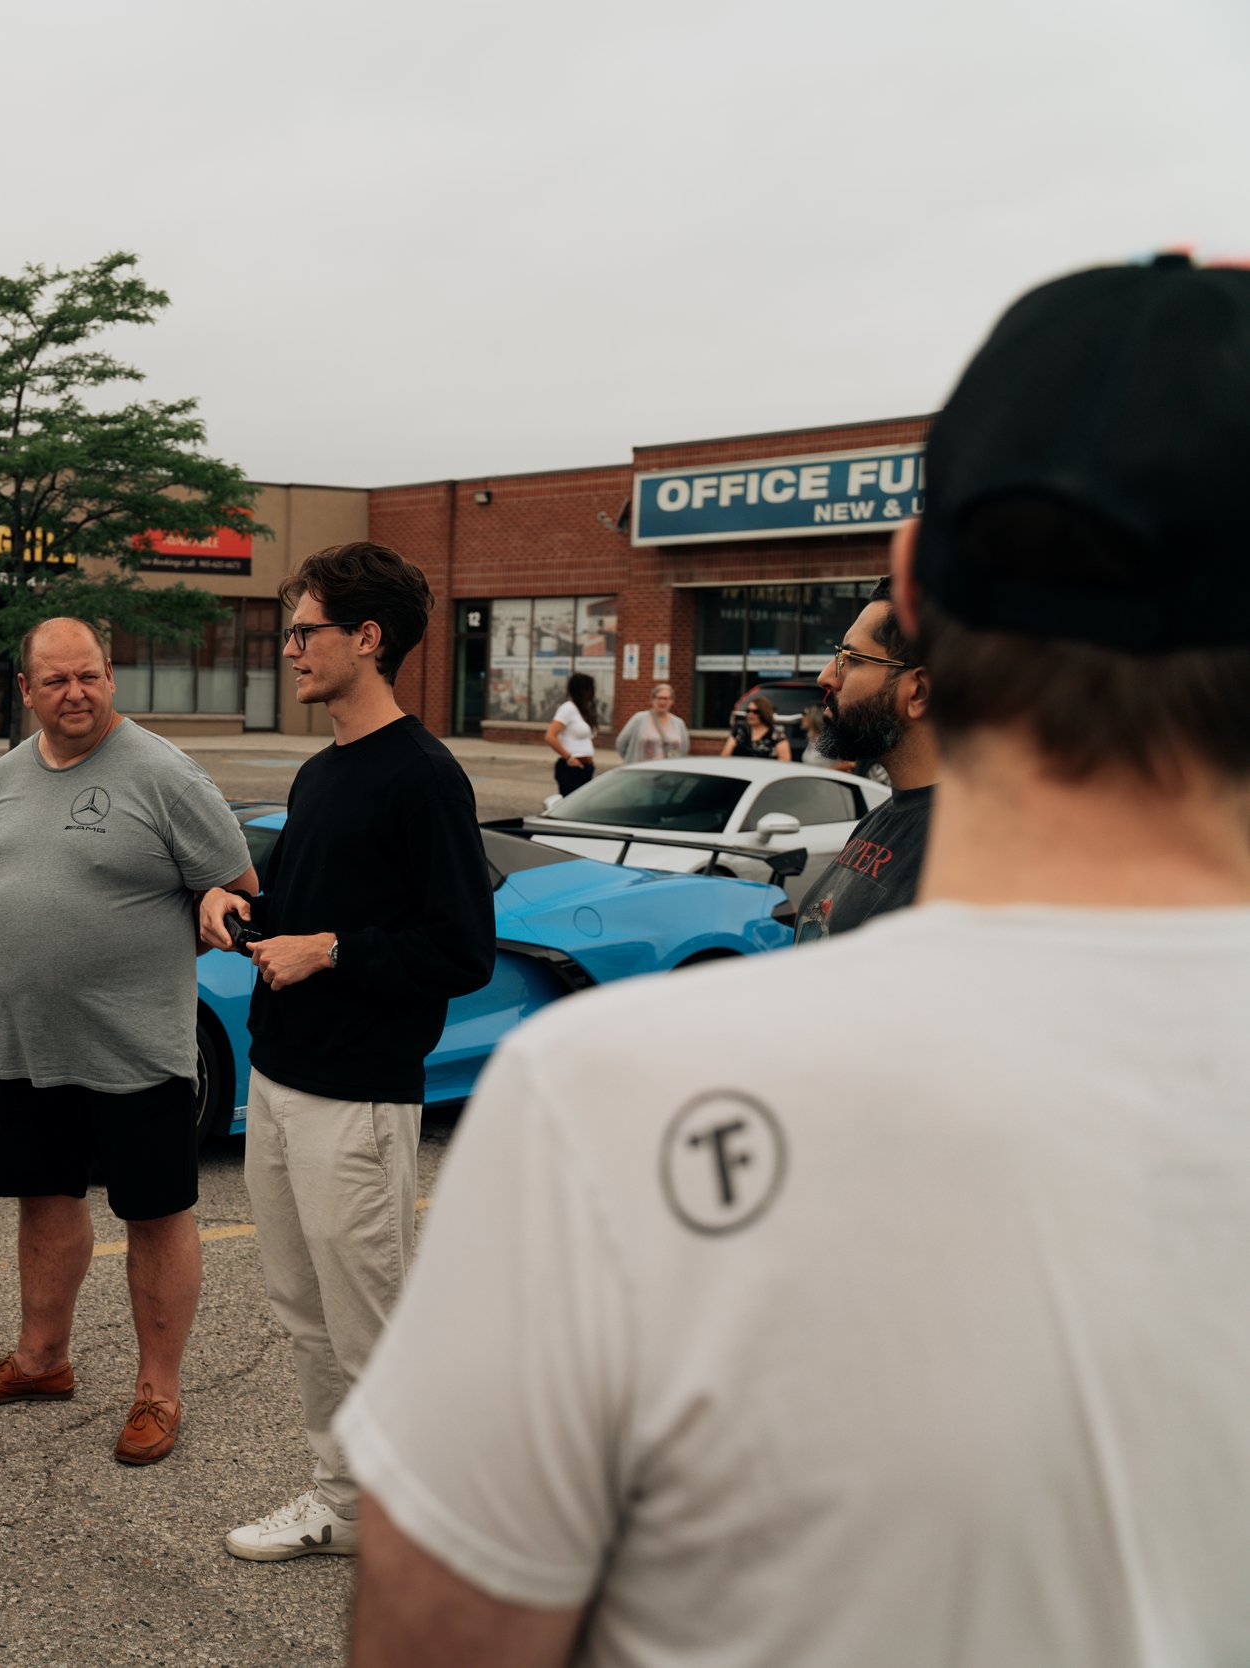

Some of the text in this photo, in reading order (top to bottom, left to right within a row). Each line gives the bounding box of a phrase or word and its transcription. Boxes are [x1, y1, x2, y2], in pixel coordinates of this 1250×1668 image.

[656, 465, 831, 512] OFFICE
[813, 501, 876, 523] NEW
[882, 499, 901, 518] &
[467, 611, 481, 627] 12
